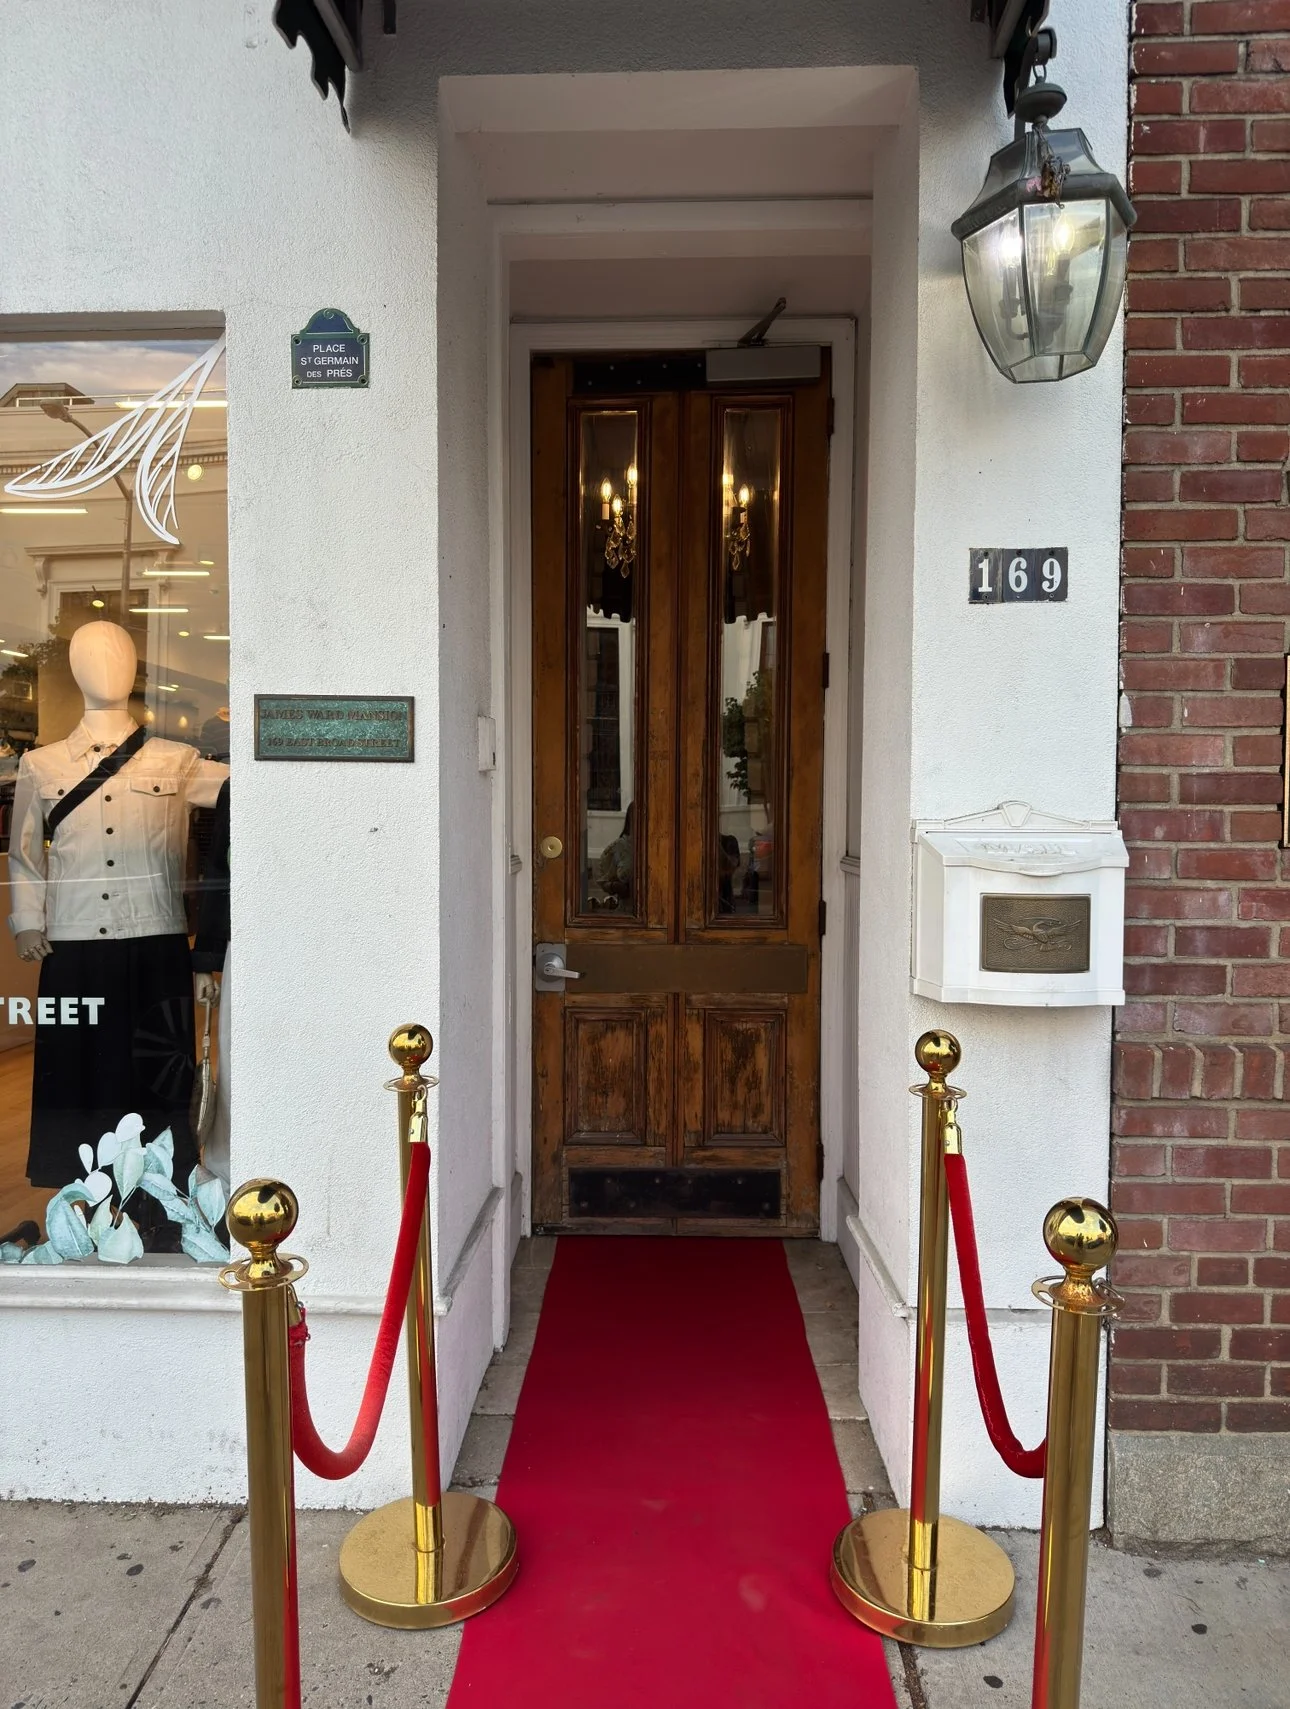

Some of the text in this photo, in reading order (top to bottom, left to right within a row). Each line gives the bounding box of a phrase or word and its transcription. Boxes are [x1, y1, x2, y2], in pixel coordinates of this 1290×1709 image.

[313, 344, 346, 353] PLACE
[314, 356, 359, 365] GERMAIN
[326, 367, 352, 377] PRÉS
[978, 557, 1062, 593] 169
[260, 709, 304, 720] JAMES
[267, 737, 284, 747] 169
[0, 997, 105, 1025] REET
